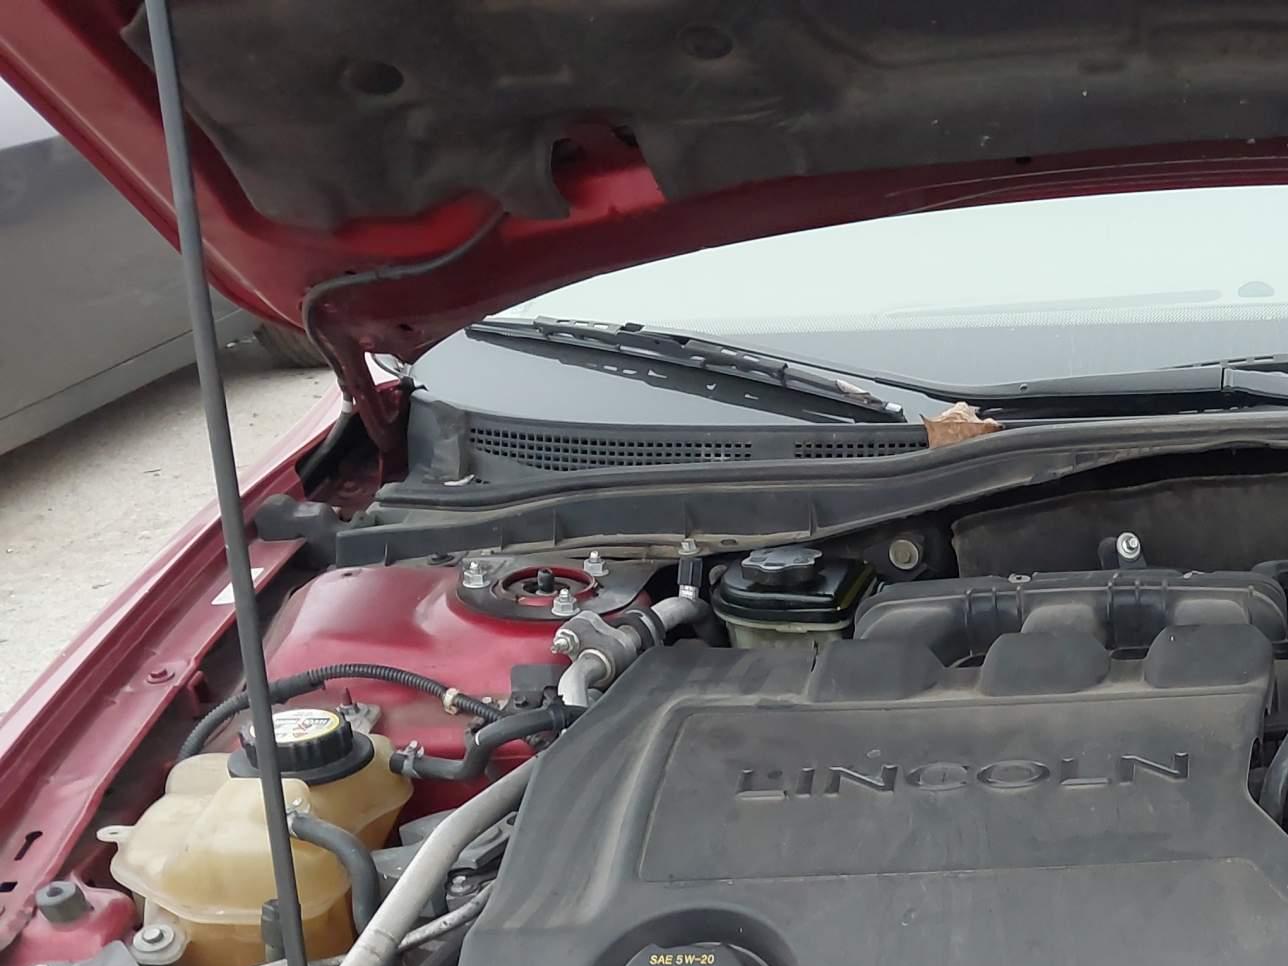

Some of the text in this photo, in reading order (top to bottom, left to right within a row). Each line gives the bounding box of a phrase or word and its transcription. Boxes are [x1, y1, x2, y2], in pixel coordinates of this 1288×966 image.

[735, 751, 1193, 801] LINCOLN
[649, 954, 715, 965] SAE 5W-20
